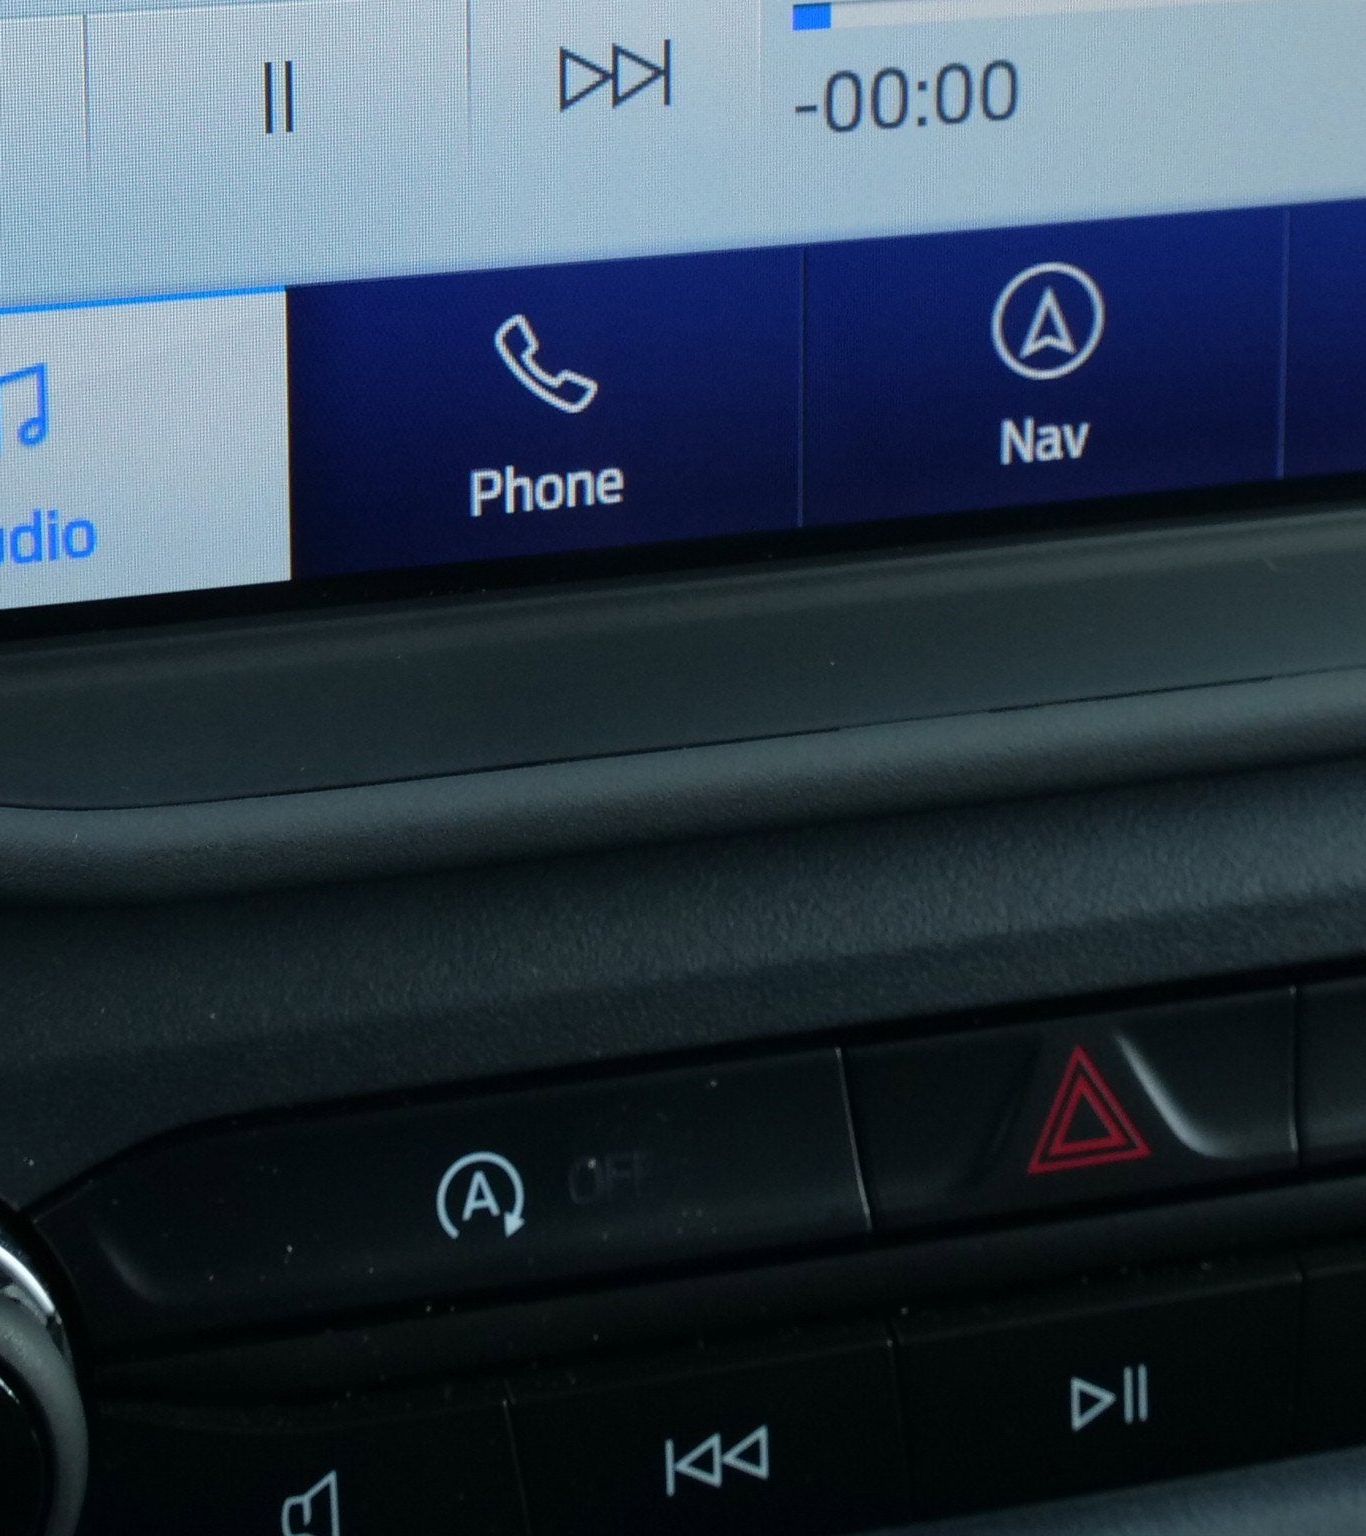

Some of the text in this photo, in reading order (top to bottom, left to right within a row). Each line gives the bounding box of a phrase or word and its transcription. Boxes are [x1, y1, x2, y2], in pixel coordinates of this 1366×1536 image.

[794, 58, 1020, 135] -00:00
[1000, 417, 1090, 465] Nav
[469, 465, 625, 517] Phone
